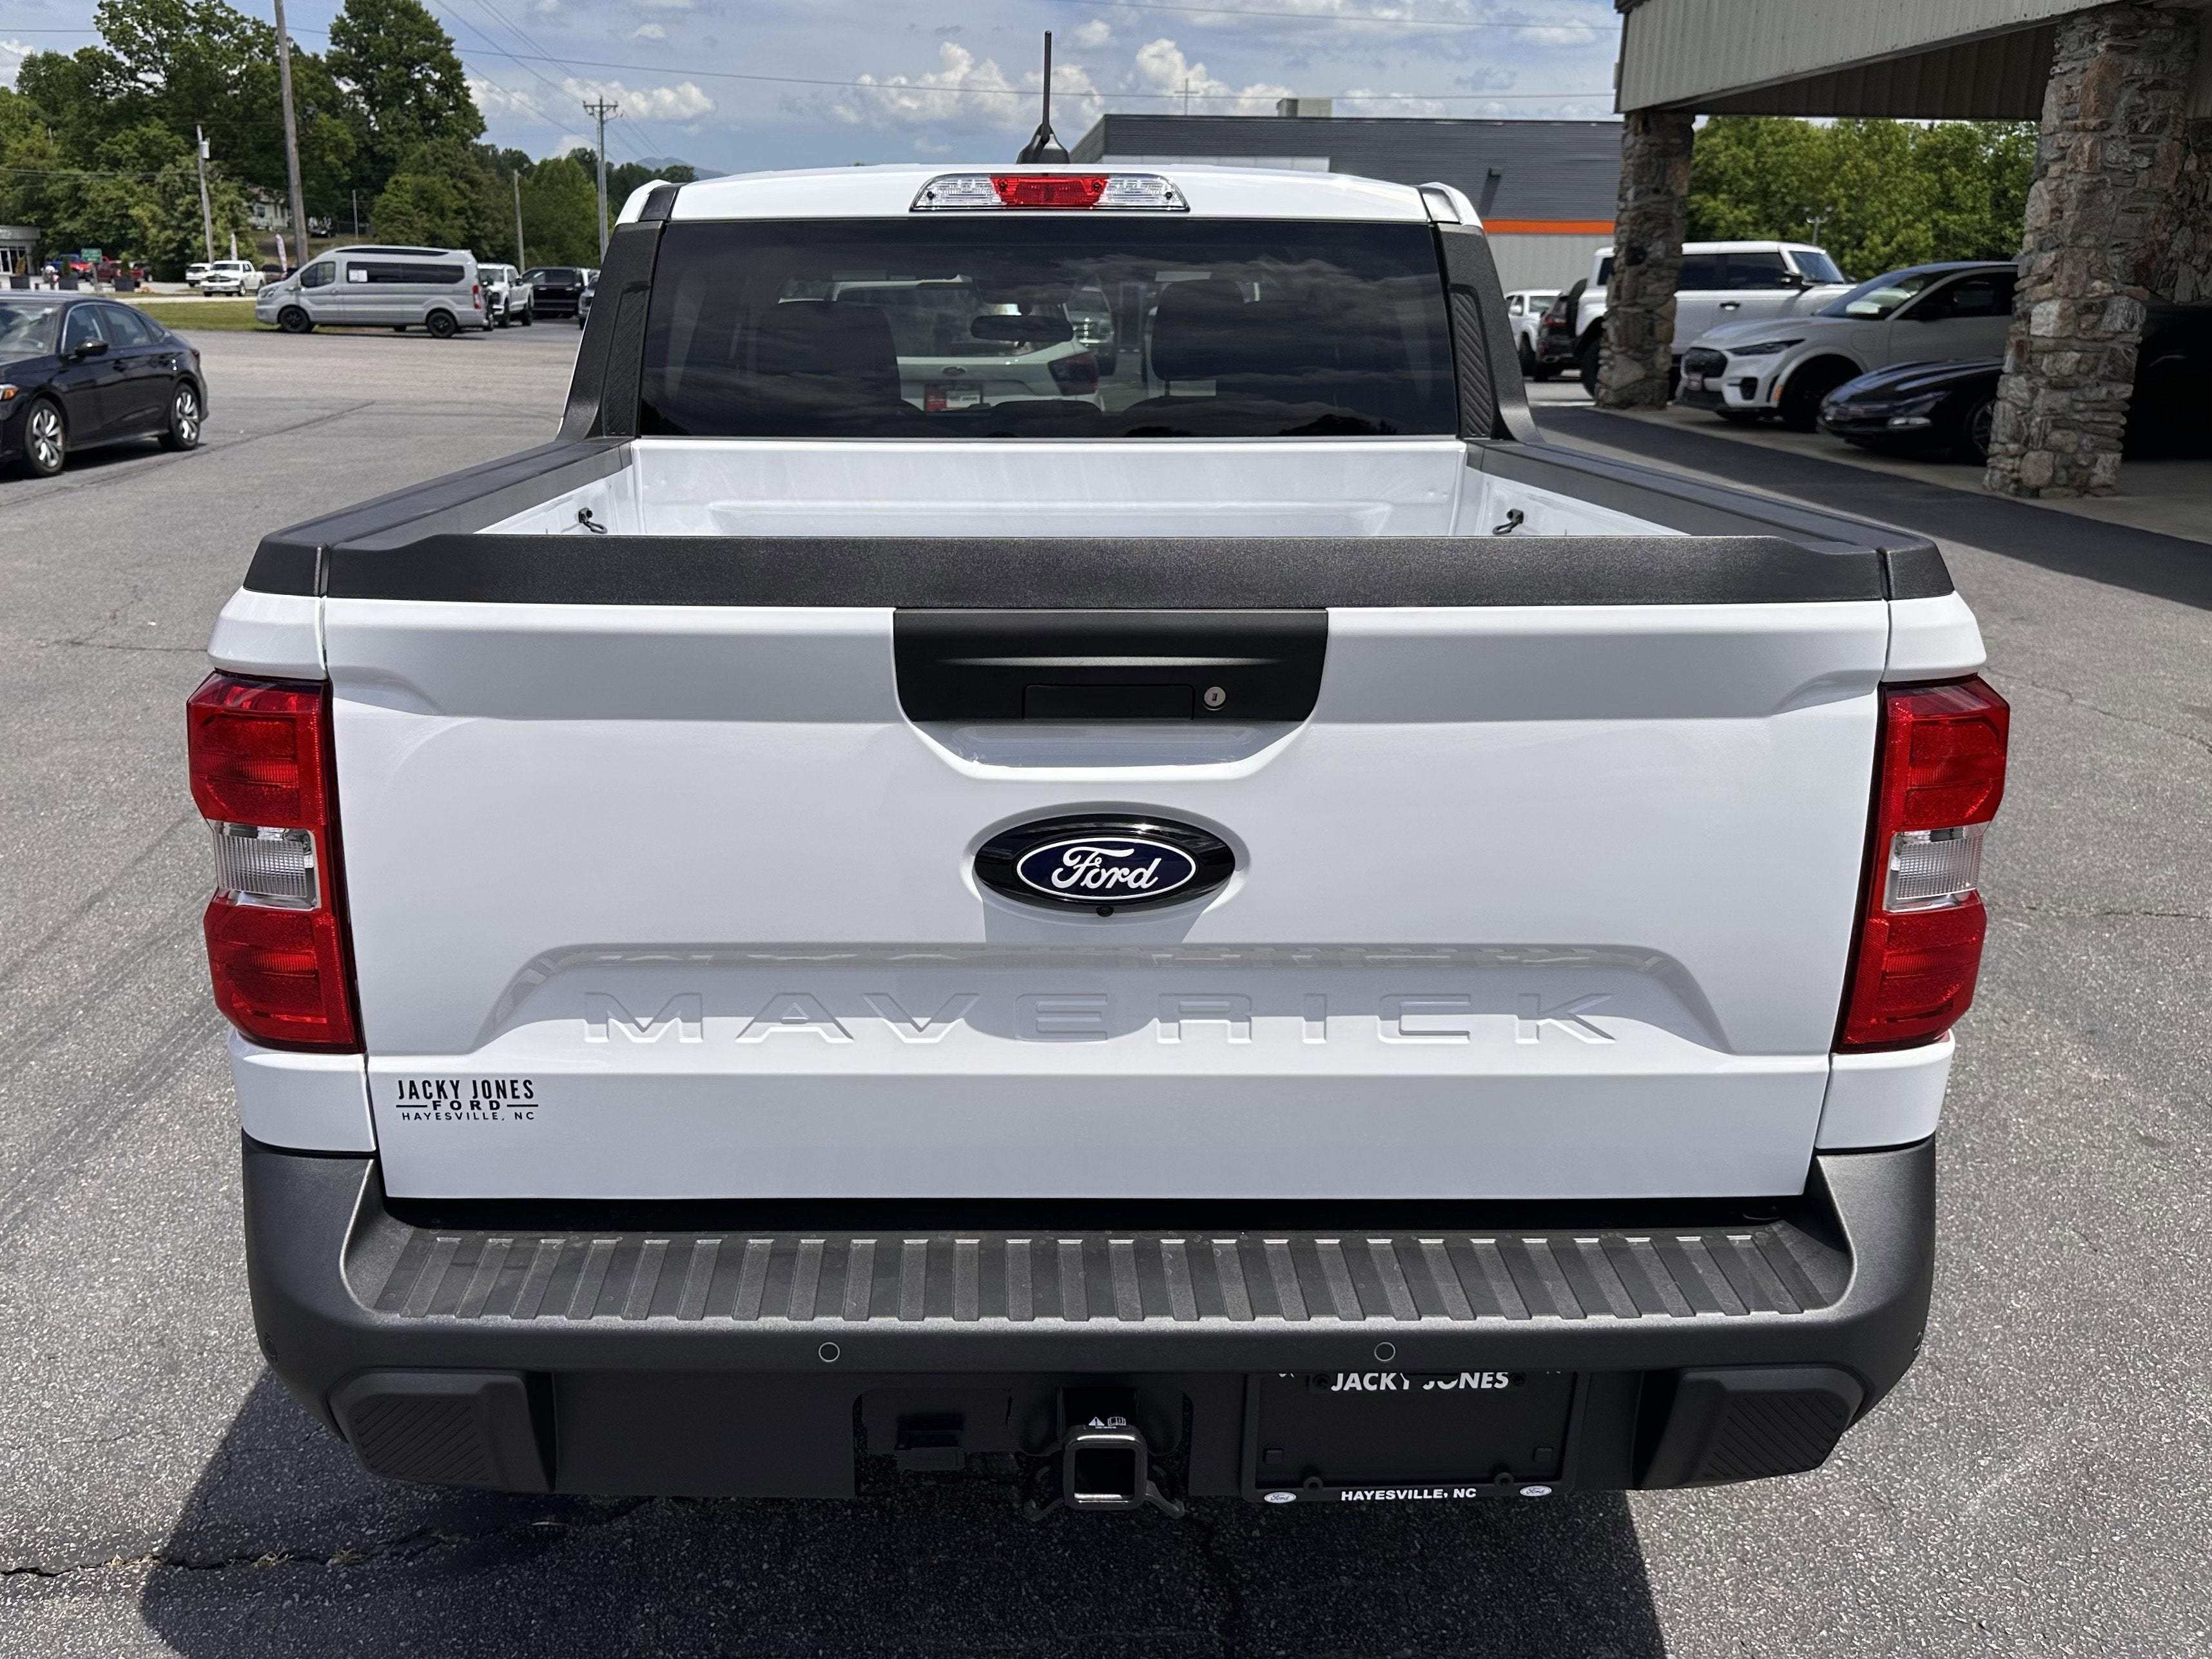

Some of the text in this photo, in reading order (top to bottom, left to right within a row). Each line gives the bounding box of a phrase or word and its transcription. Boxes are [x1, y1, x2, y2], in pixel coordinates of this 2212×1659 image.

[1051, 846, 1161, 889] Ford
[584, 992, 1616, 1043] MAVERICK
[398, 1080, 534, 1100] JACKY JONES
[432, 1100, 501, 1111] FORD
[402, 1112, 535, 1121] HAYESVILLE, NC
[1341, 1488, 1477, 1501] HAYESVILLE, NC
